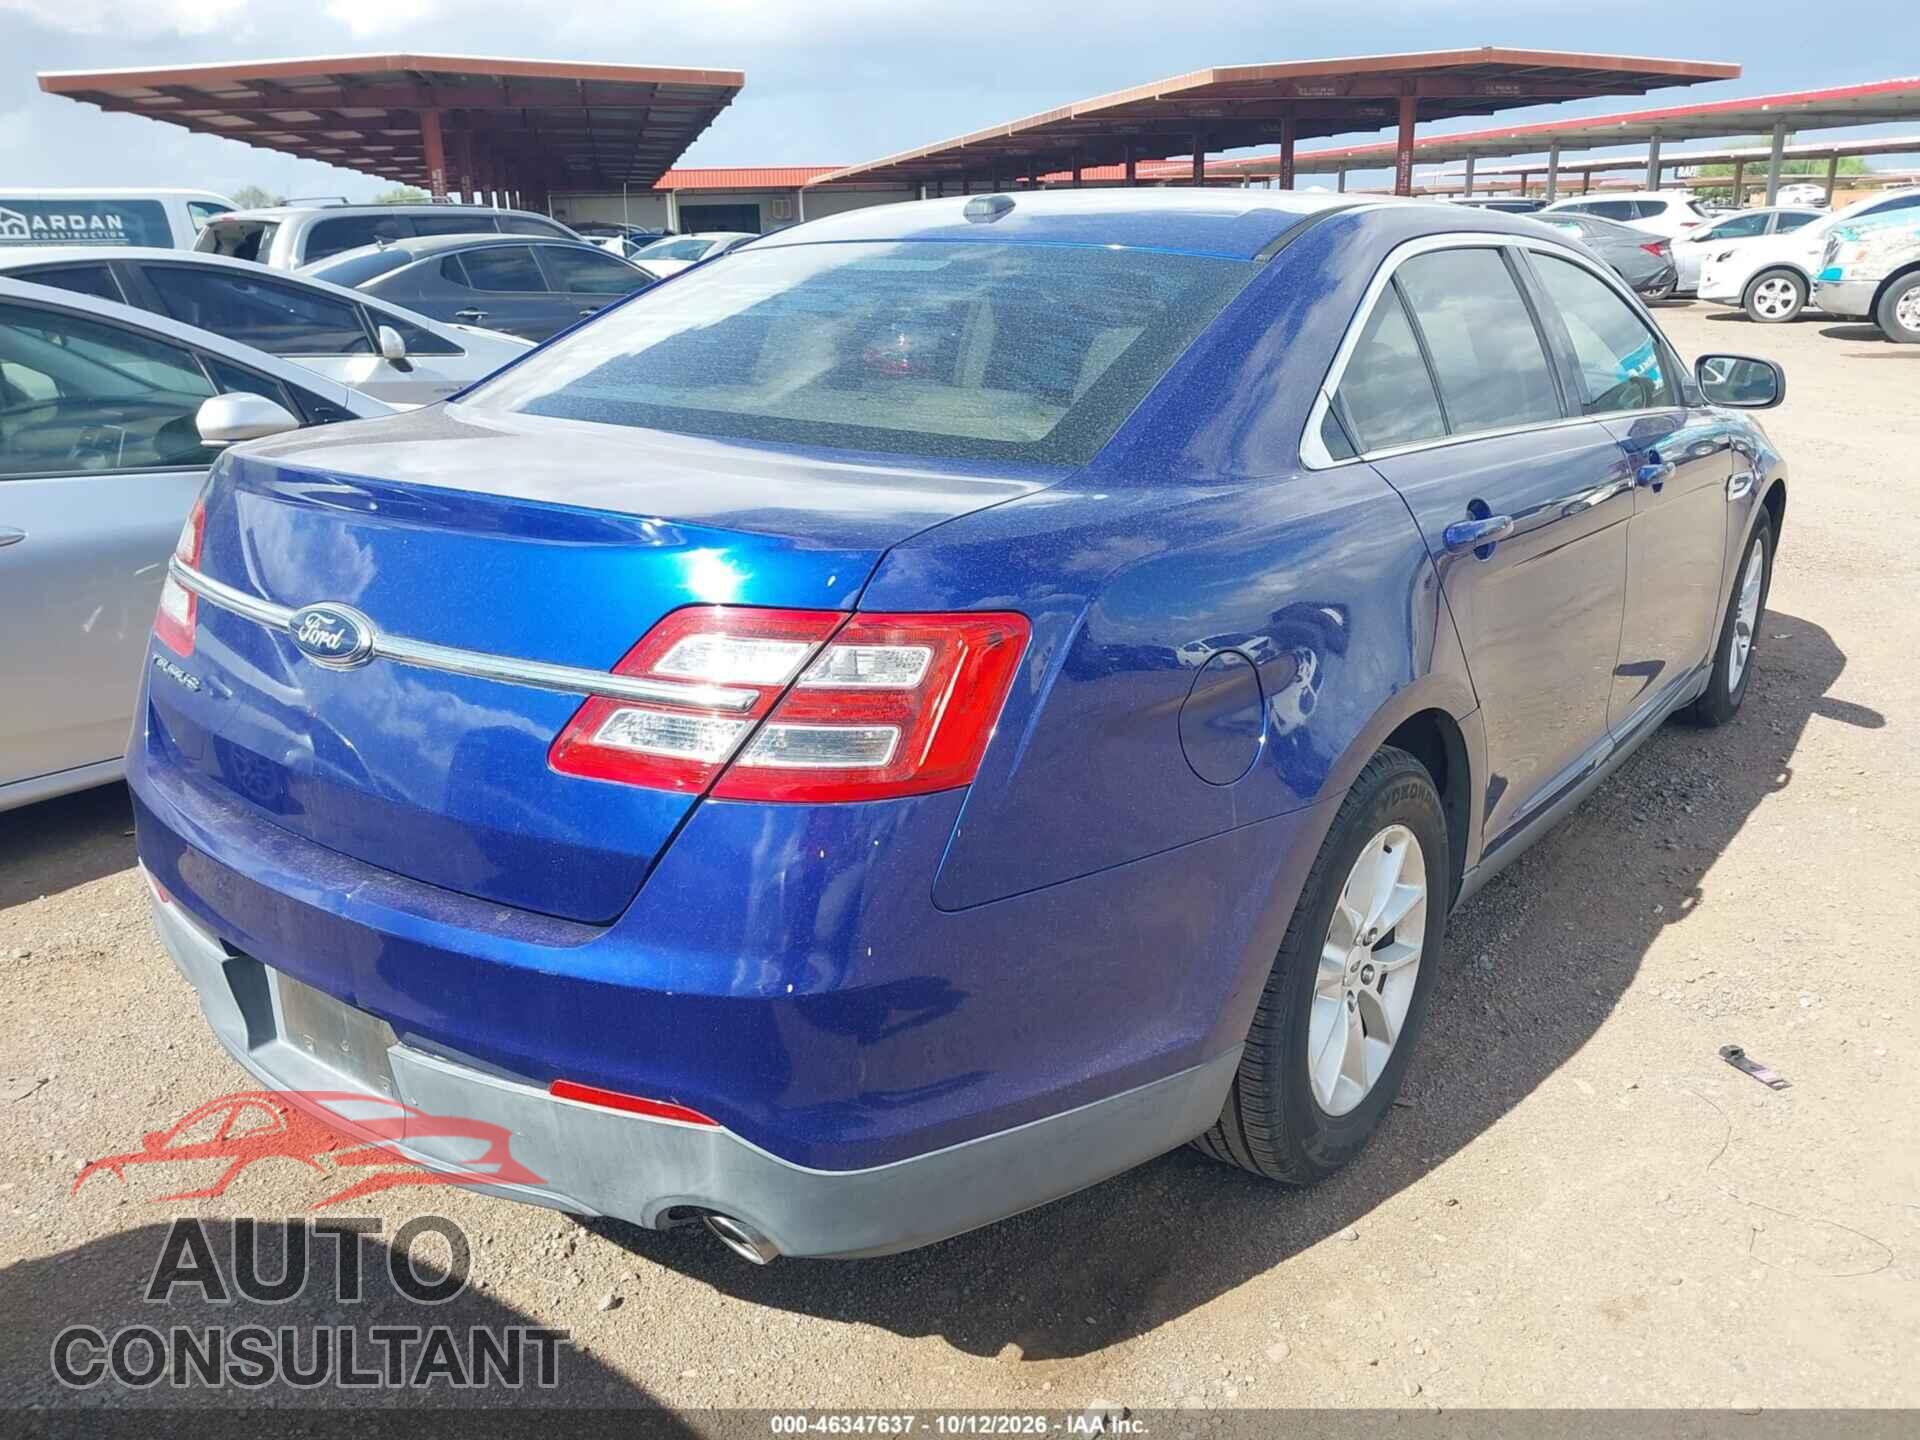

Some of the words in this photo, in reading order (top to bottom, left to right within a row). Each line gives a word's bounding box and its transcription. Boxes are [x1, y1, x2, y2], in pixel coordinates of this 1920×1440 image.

[31, 214, 124, 230] ARDAN
[32, 231, 126, 240] CONSTRUCTION
[299, 612, 345, 650] Ford
